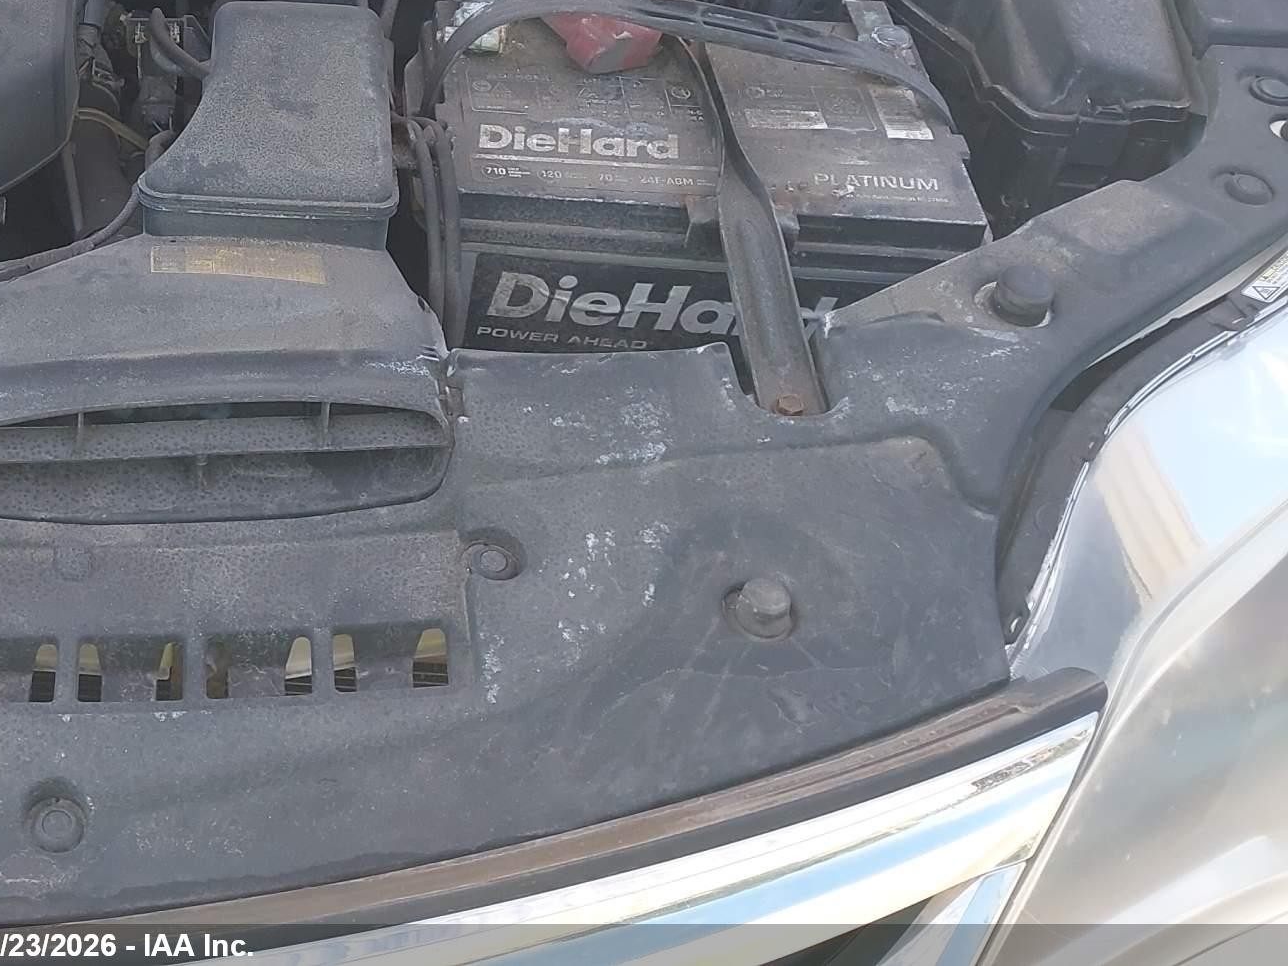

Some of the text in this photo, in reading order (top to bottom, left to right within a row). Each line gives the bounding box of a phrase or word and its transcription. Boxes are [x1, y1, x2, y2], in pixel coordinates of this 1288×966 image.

[478, 123, 679, 160] DieHard
[486, 166, 506, 176] 710
[541, 170, 562, 179] 120
[814, 173, 940, 191] PLATINUM
[476, 326, 648, 350] POWER AHEAD
